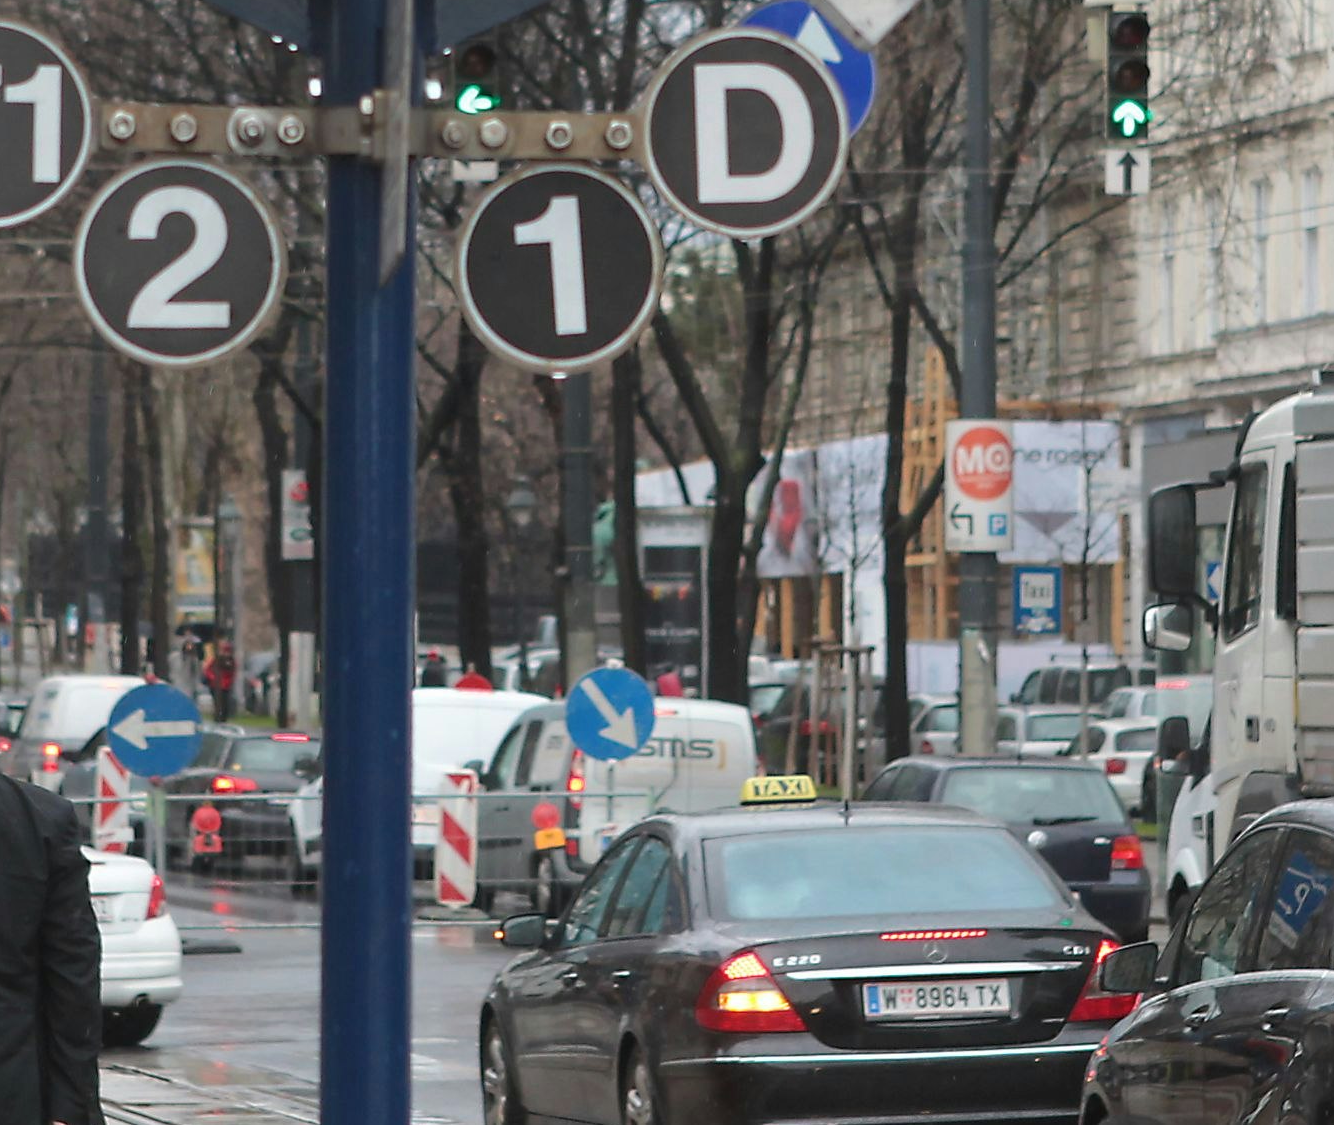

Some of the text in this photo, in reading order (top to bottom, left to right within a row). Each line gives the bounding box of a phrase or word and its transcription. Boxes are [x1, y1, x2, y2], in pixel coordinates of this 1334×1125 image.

[693, 63, 815, 205] D
[126, 186, 231, 330] 2
[513, 195, 589, 336] 1
[753, 780, 810, 797] TAXI
[882, 984, 1003, 1010] W 8964 TX
